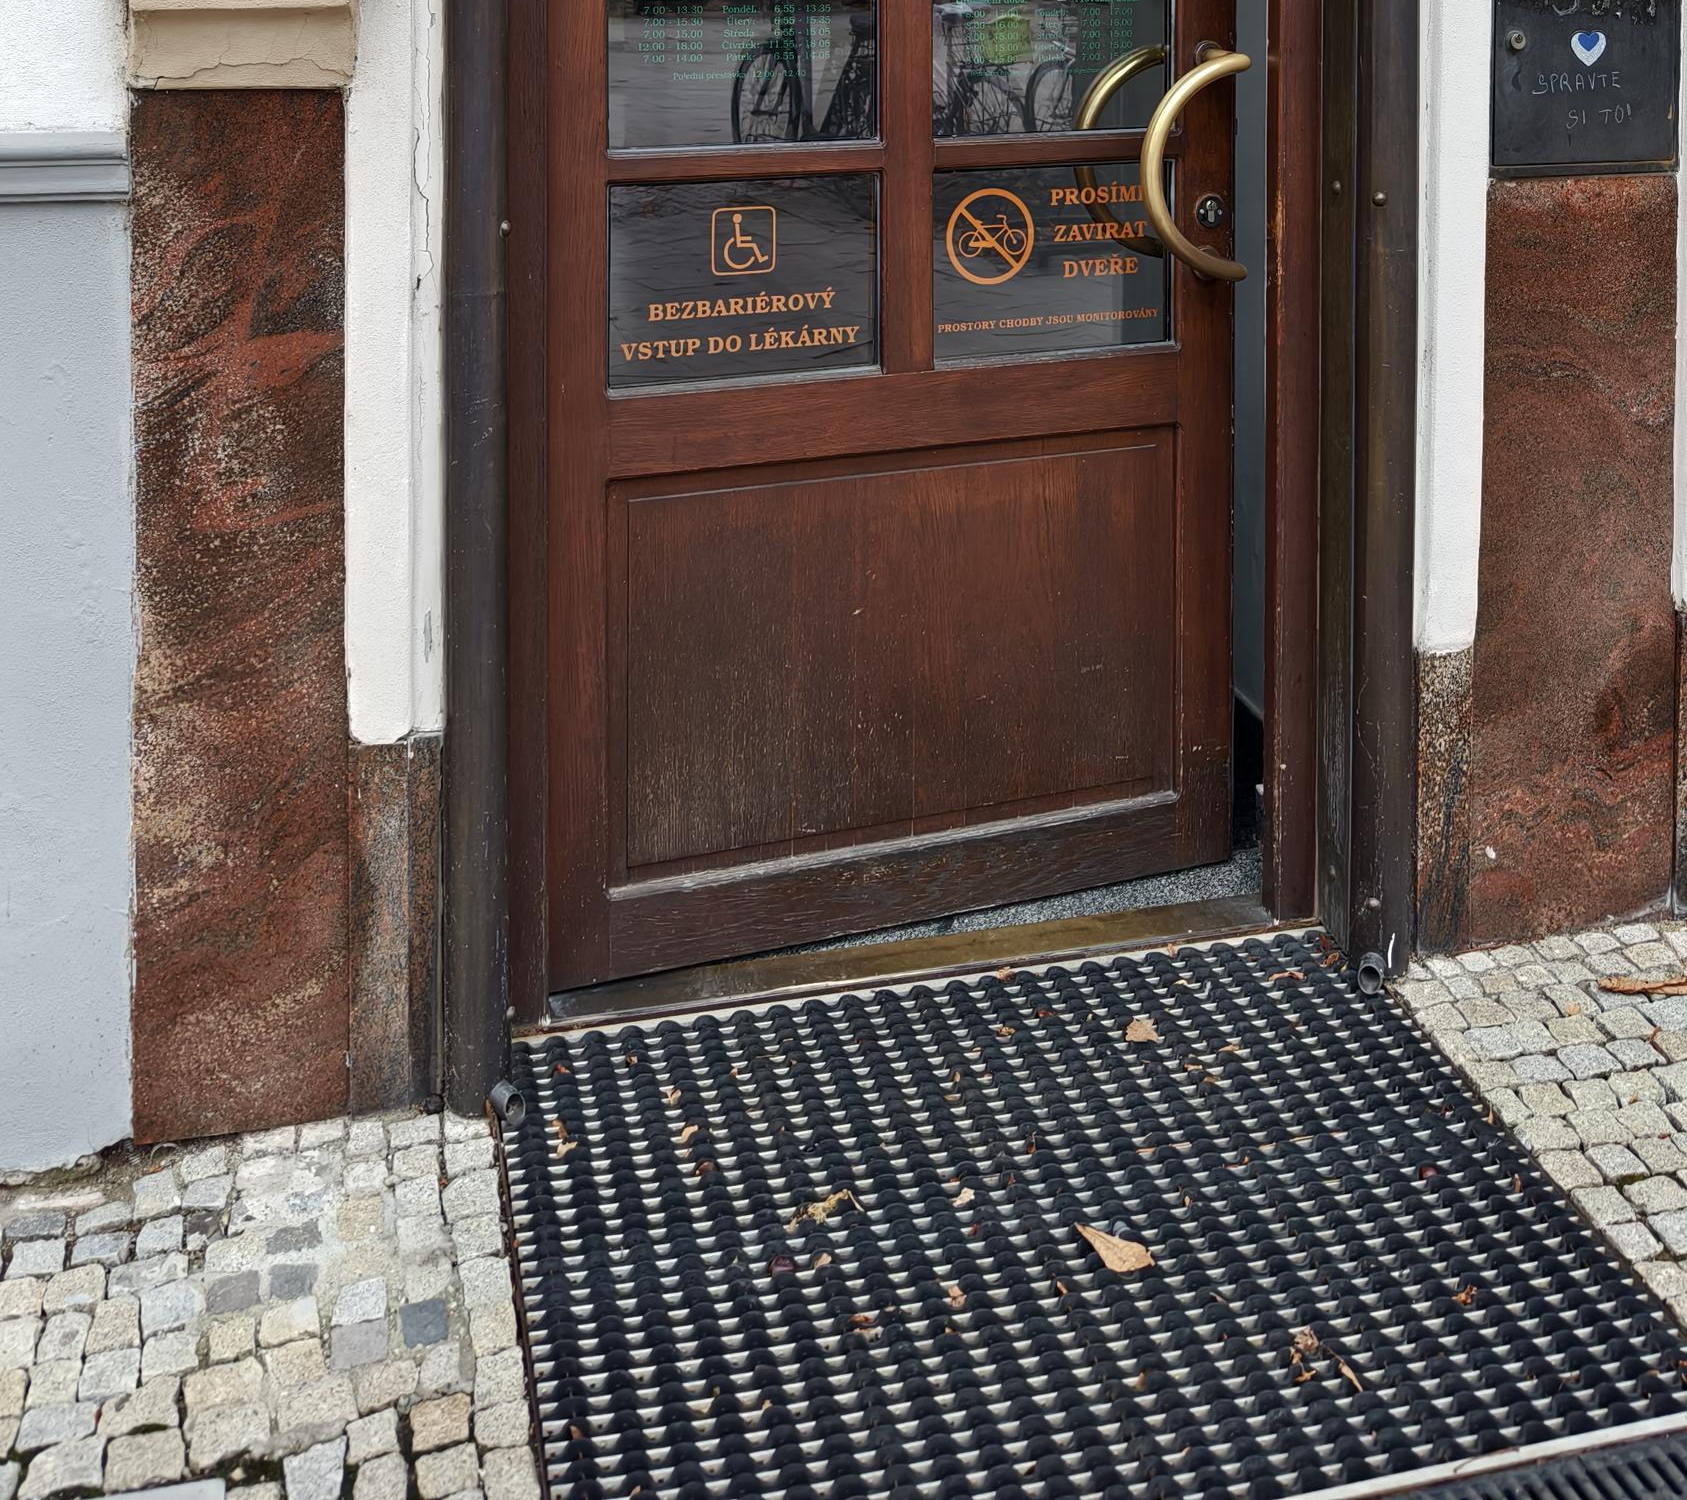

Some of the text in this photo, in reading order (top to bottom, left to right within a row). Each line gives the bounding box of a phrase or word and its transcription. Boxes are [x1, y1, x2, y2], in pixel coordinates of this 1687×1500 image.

[1532, 71, 1621, 95] SPRAVTE
[1566, 109, 1586, 129] SI
[1063, 253, 1138, 278] DVEŘE
[648, 286, 836, 322] BEZBARIÉROVÝ
[937, 308, 1159, 333] PROSTORY CHODBY JSOU MONITOROVÁNY
[621, 325, 860, 362] VSTUP DO LÉKÁRNY
